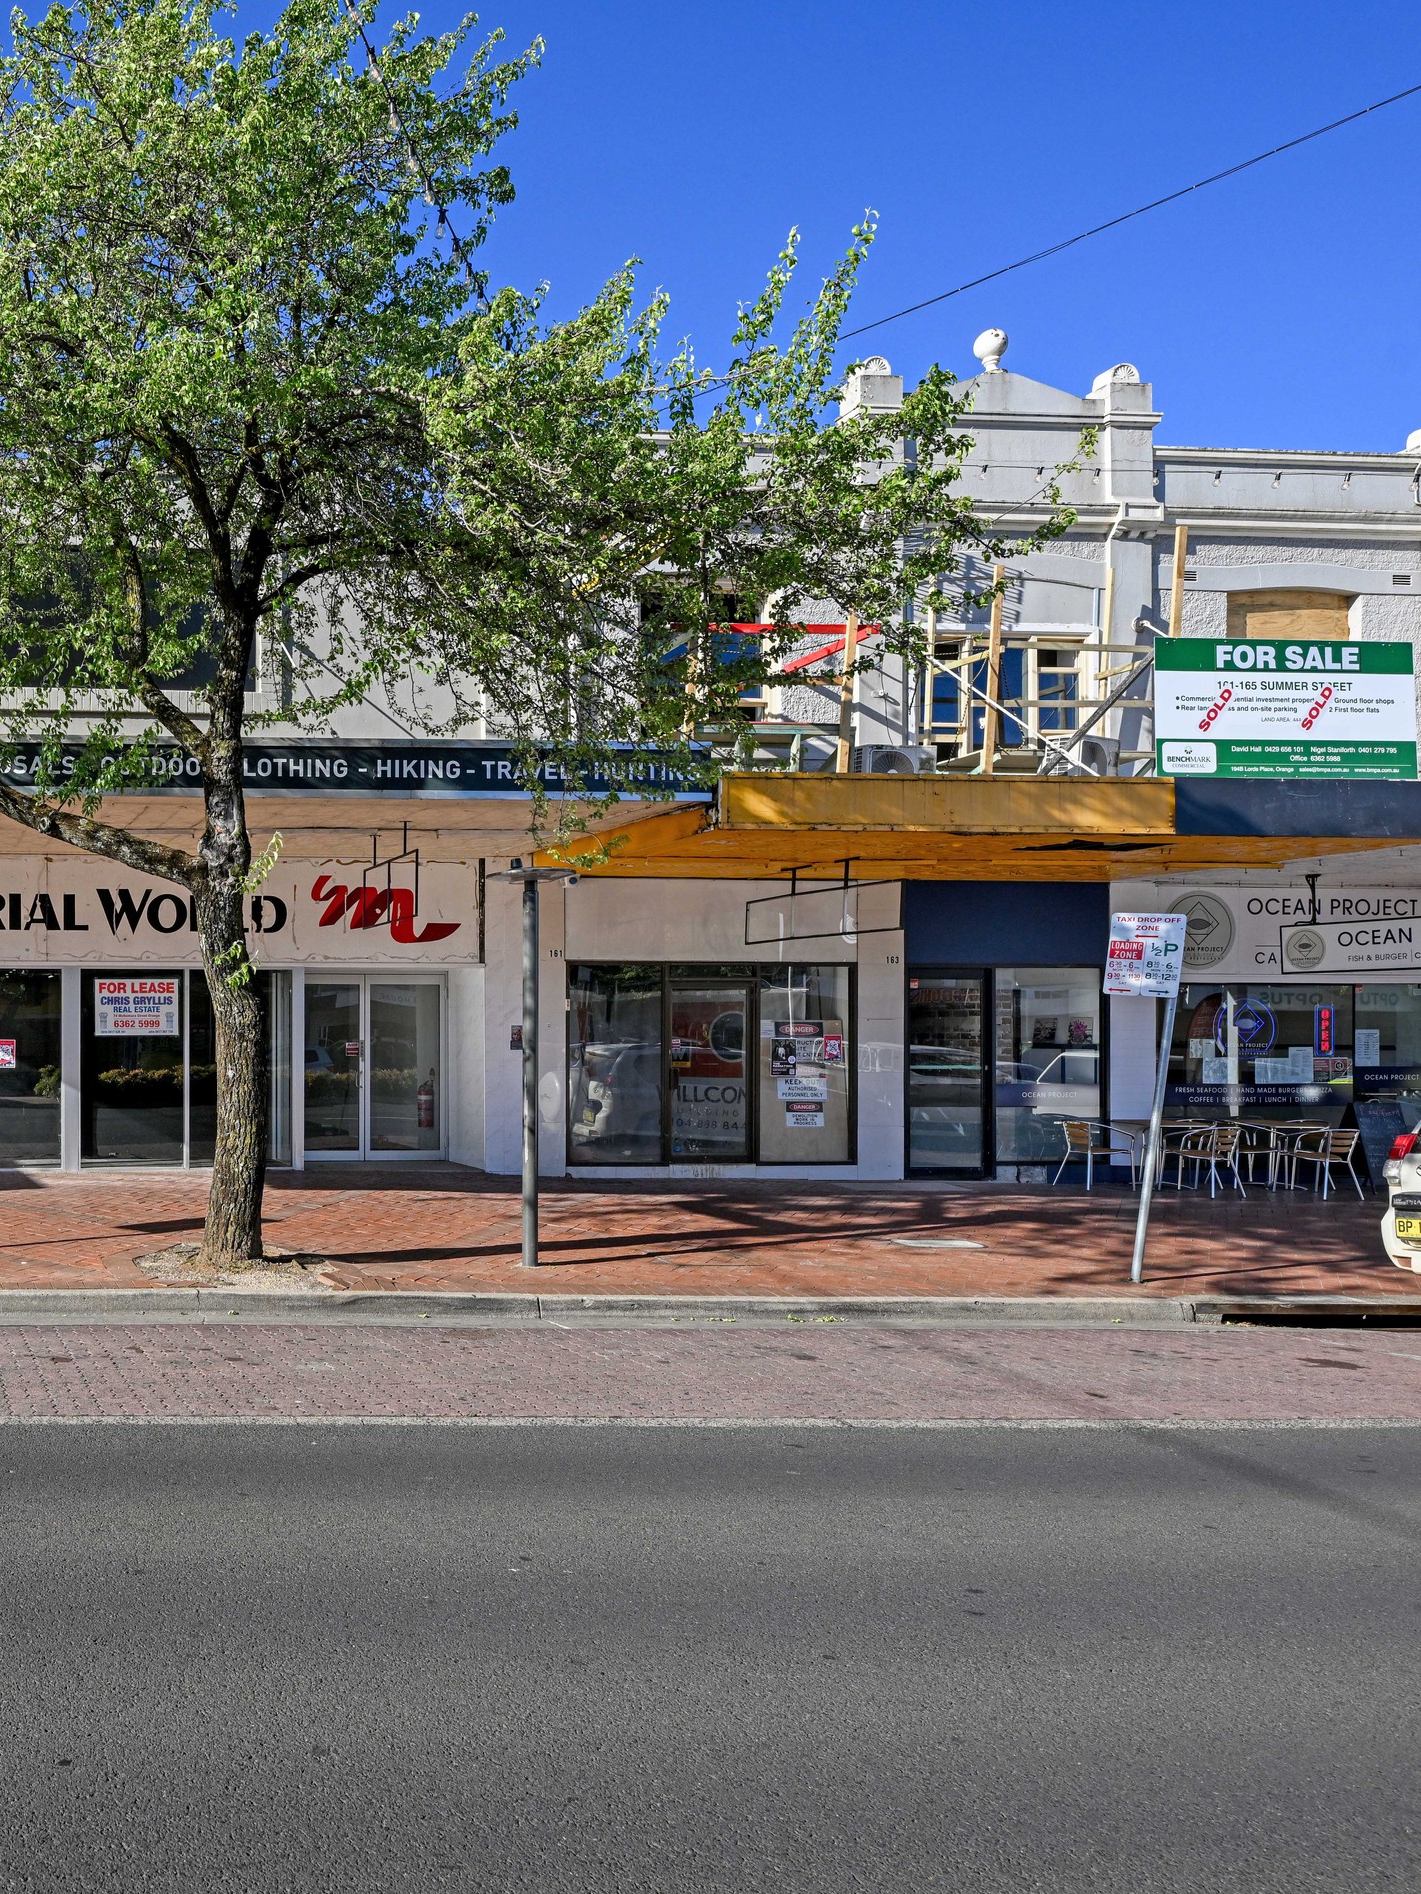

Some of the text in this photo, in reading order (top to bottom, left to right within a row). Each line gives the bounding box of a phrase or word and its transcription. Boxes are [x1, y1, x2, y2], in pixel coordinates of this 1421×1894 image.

[1215, 644, 1360, 671] FOR SALE
[1261, 681, 1308, 691] SUMMER
[1198, 688, 1233, 732] SOLD
[1301, 686, 1333, 731] SOLD
[1310, 746, 1326, 754] Nigel
[1166, 755, 1211, 763] BENCHMARK
[243, 757, 348, 778] LOTHING
[376, 759, 461, 779] HIKING
[96, 888, 287, 935] WOD
[1247, 898, 1418, 916] OCEAN PROJECT
[1337, 927, 1413, 947] OCEAN
[1111, 941, 1143, 950] LOADING
[885, 956, 900, 964] 163
[1113, 950, 1138, 959] ZONE
[1374, 952, 1408, 961] BURGER
[98, 982, 175, 994] FOR LEASE
[100, 996, 174, 1006] CHRIS GRYLLIS
[113, 1020, 160, 1028] 6362 5999
[1320, 1009, 1330, 1052] OPEN
